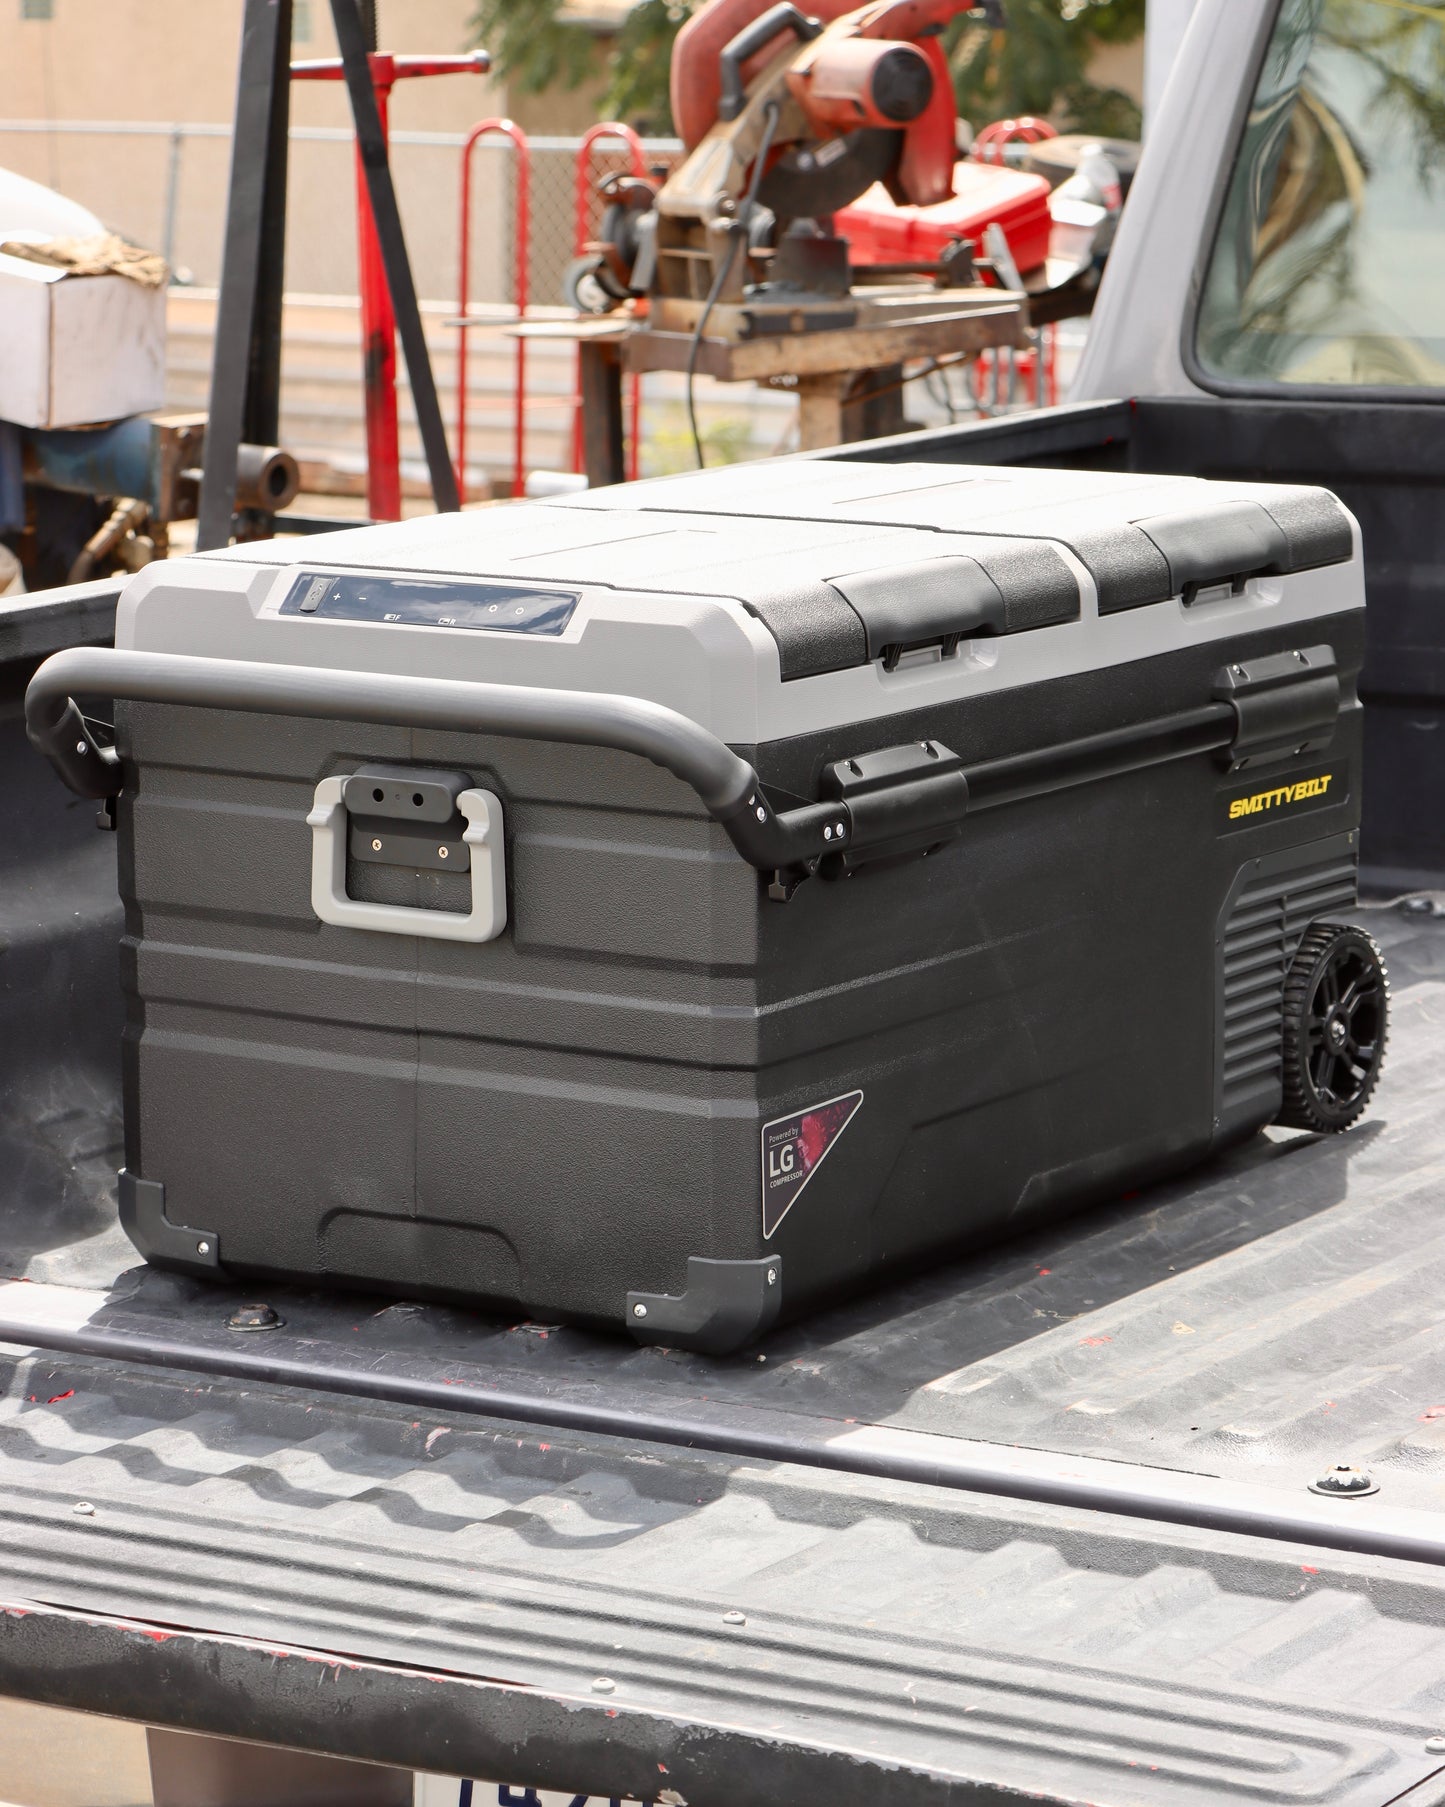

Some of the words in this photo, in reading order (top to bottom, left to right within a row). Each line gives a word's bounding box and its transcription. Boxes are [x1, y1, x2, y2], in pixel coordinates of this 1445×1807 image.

[1229, 775, 1332, 819] SMITTYBILT
[769, 1129, 791, 1143] Powered
[792, 1127, 799, 1137] by
[769, 1144, 794, 1178] LG
[769, 1170, 804, 1189] COMPRESSOR
